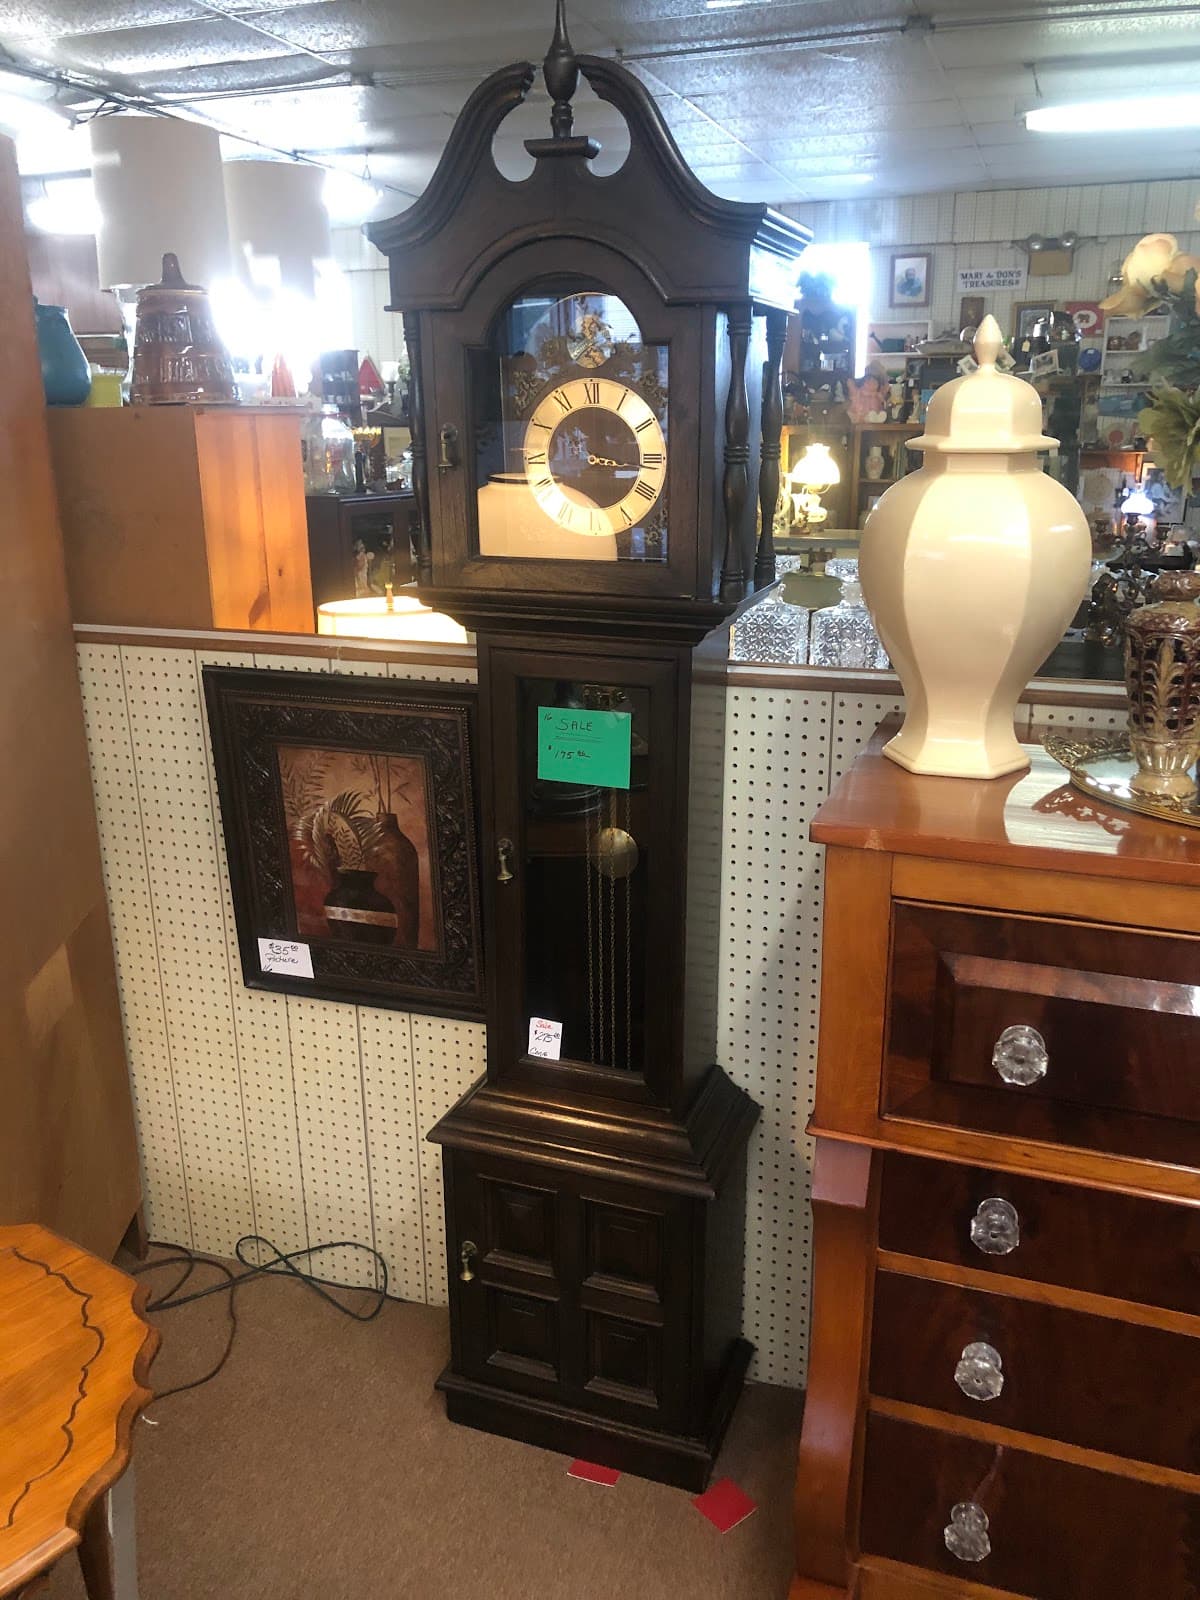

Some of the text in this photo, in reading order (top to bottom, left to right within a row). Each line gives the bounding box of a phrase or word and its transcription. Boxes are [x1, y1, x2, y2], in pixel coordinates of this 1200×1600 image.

[961, 272, 983, 280] MARY
[584, 383, 600, 404] XII
[635, 418, 653, 433] II
[643, 453, 662, 464] III
[555, 719, 593, 732] SALE
